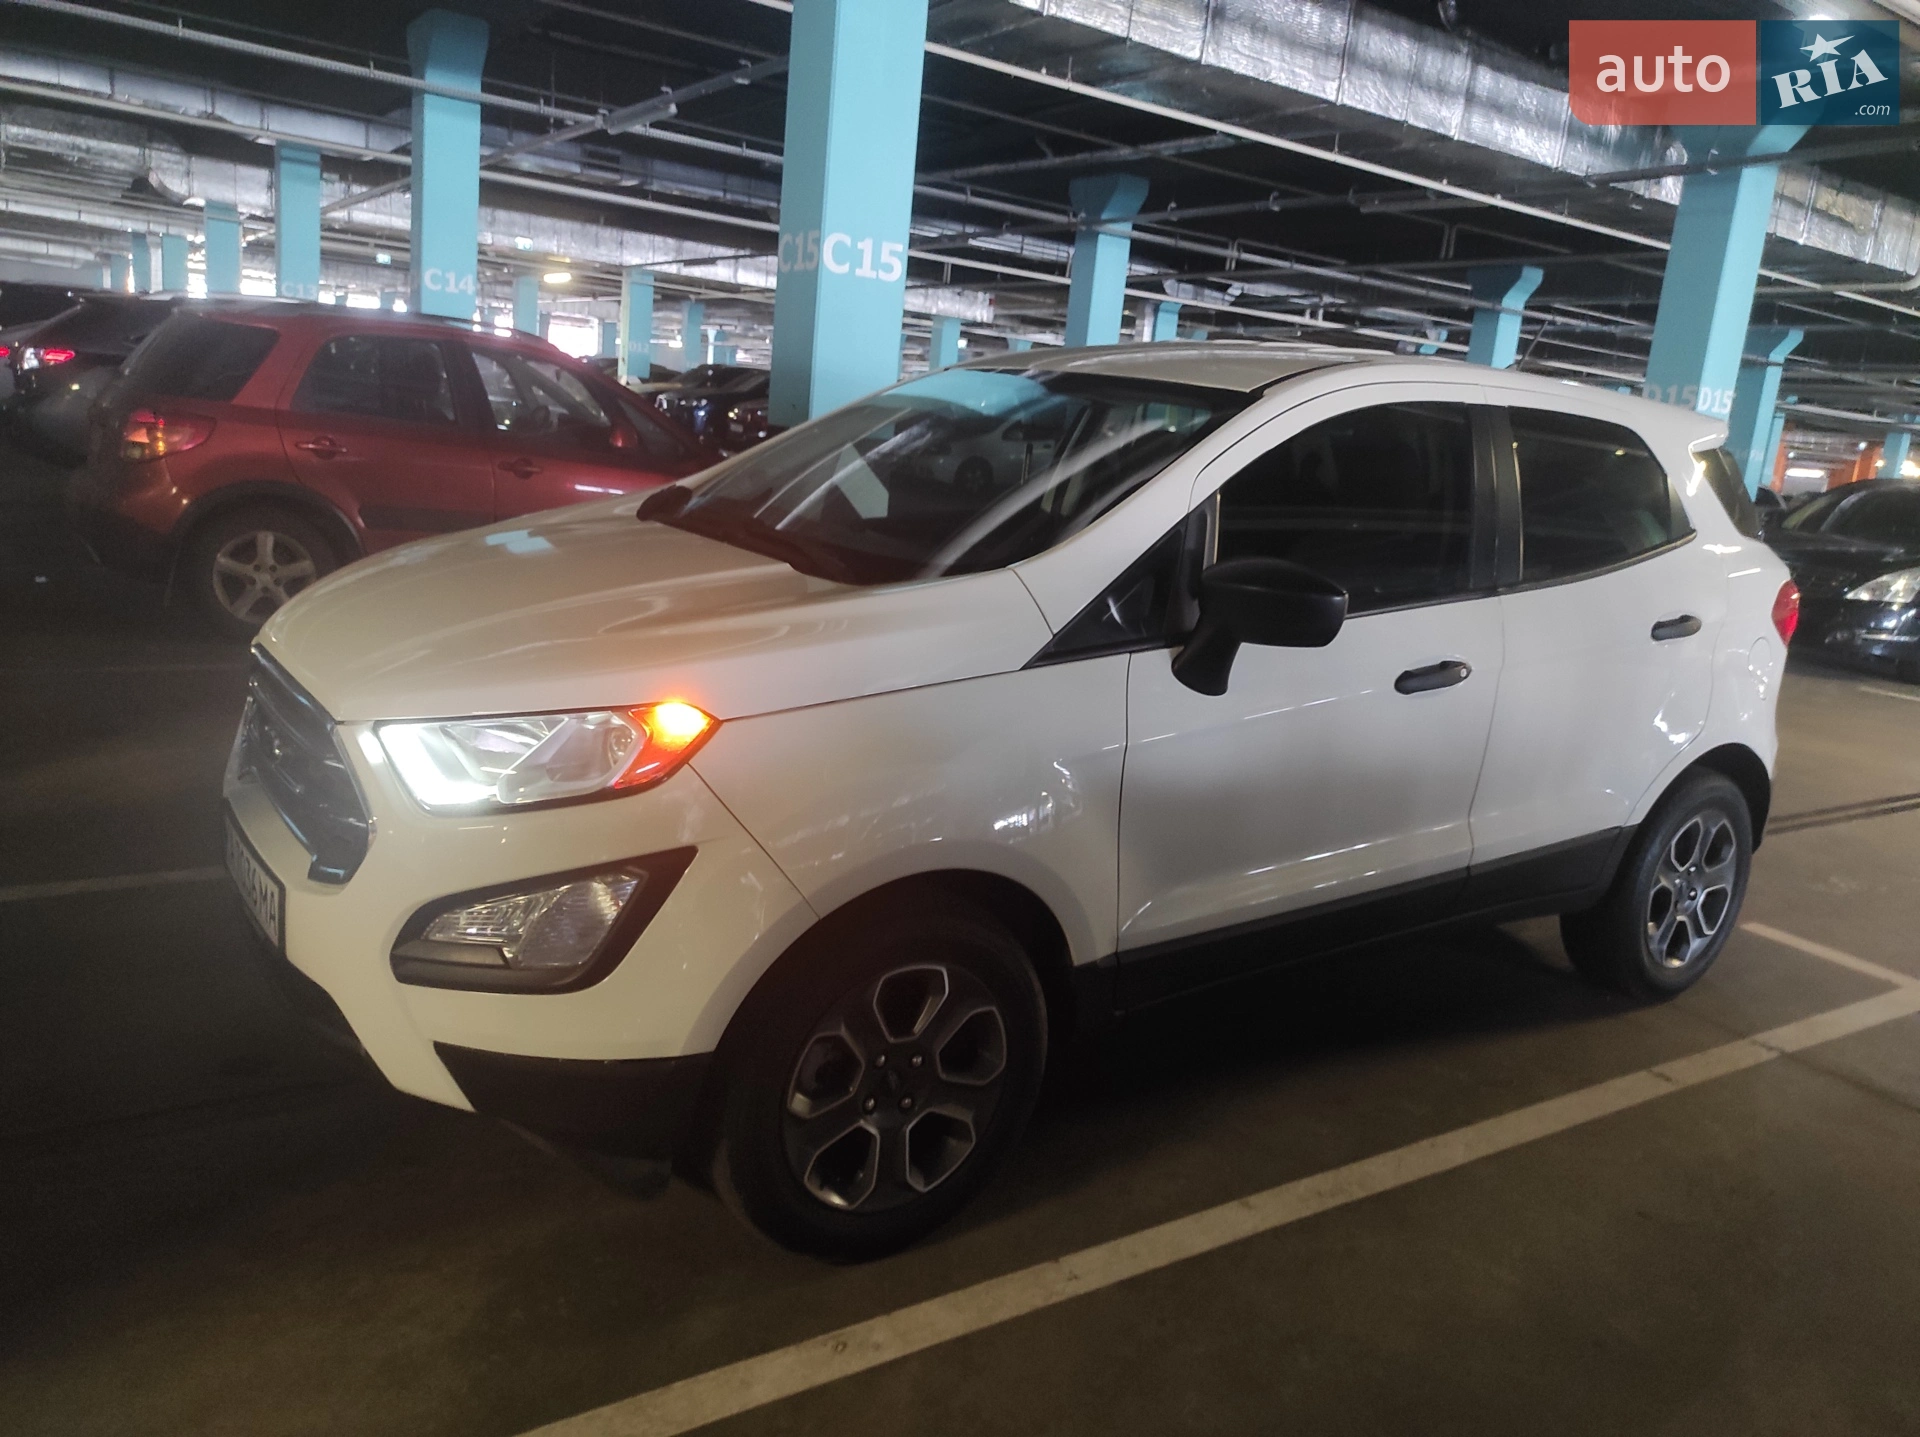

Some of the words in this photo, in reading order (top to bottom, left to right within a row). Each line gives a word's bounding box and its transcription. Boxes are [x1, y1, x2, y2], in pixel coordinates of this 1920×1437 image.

[778, 230, 821, 274] C15
[822, 232, 904, 283] C15
[424, 268, 476, 295] C14
[1697, 387, 1736, 414] D15
